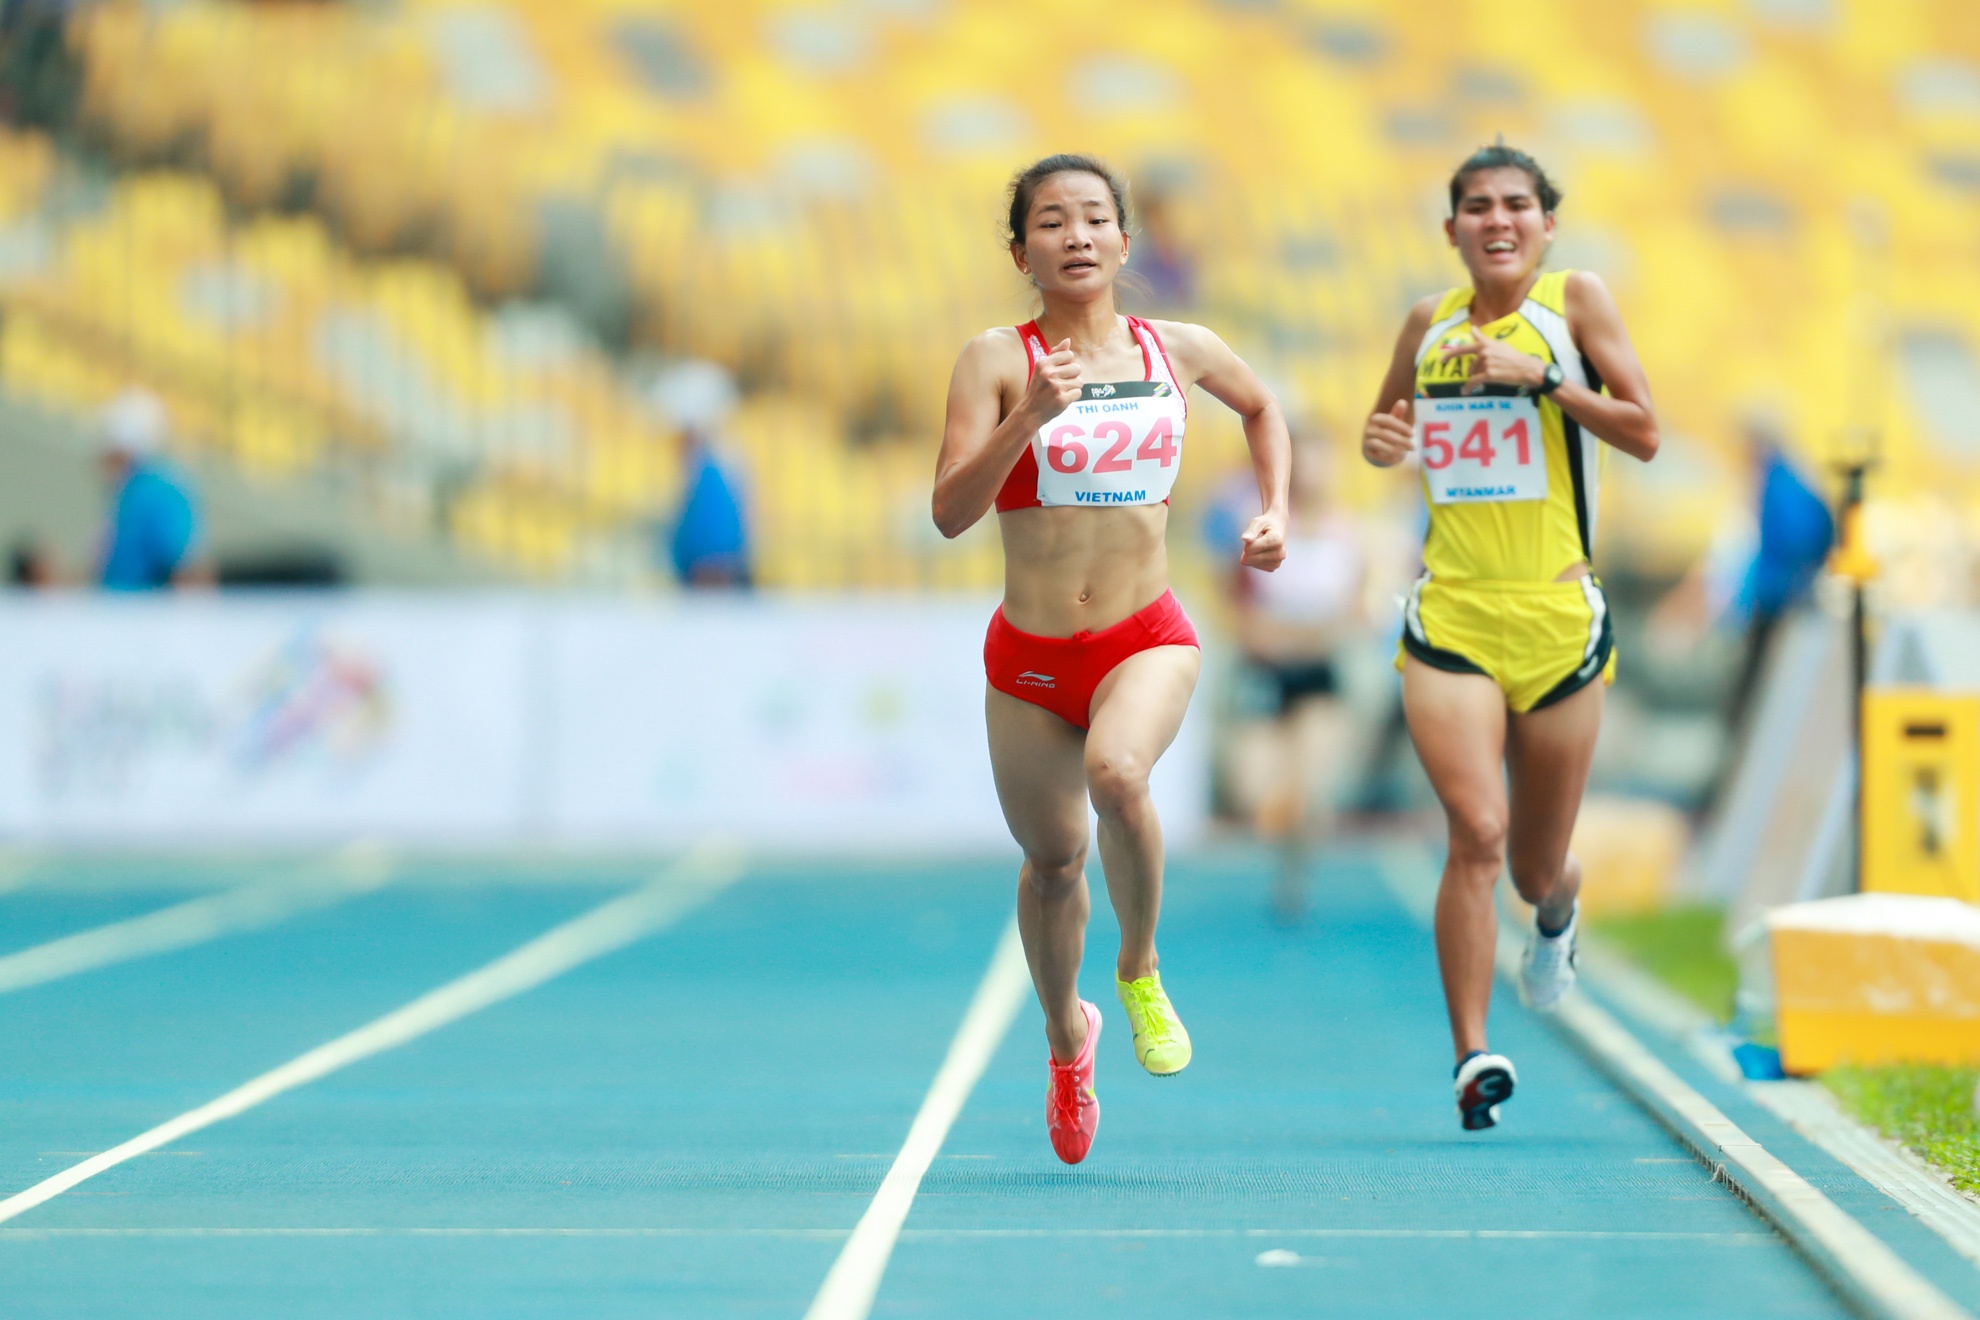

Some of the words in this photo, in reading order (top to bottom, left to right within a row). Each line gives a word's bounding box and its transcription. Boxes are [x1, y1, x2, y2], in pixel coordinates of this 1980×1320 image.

[1076, 404, 1098, 415] THI
[1102, 402, 1139, 413] OANH
[1047, 416, 1177, 474] 624
[1422, 418, 1531, 470] 541
[1075, 490, 1146, 503] VIETNAM
[1446, 485, 1516, 497] MYANMAR
[1016, 679, 1056, 689] LI-NING
